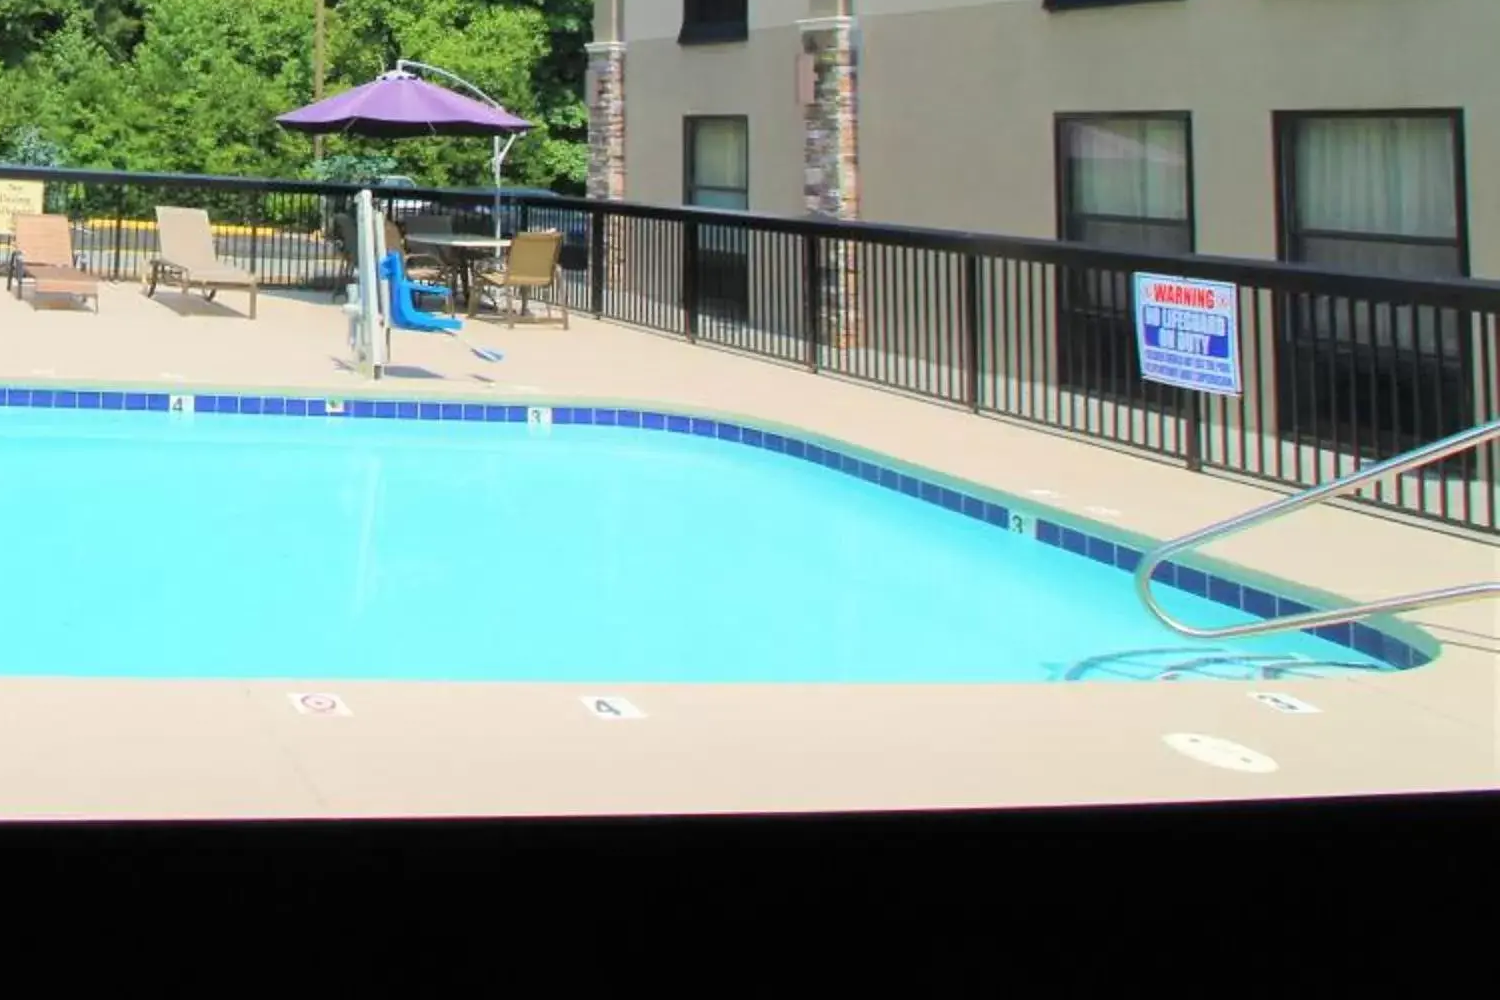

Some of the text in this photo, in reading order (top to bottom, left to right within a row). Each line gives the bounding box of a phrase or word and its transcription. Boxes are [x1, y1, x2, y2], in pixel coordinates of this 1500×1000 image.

[1154, 284, 1215, 309] WARNING
[171, 397, 184, 412] 4
[595, 699, 622, 717] 4
